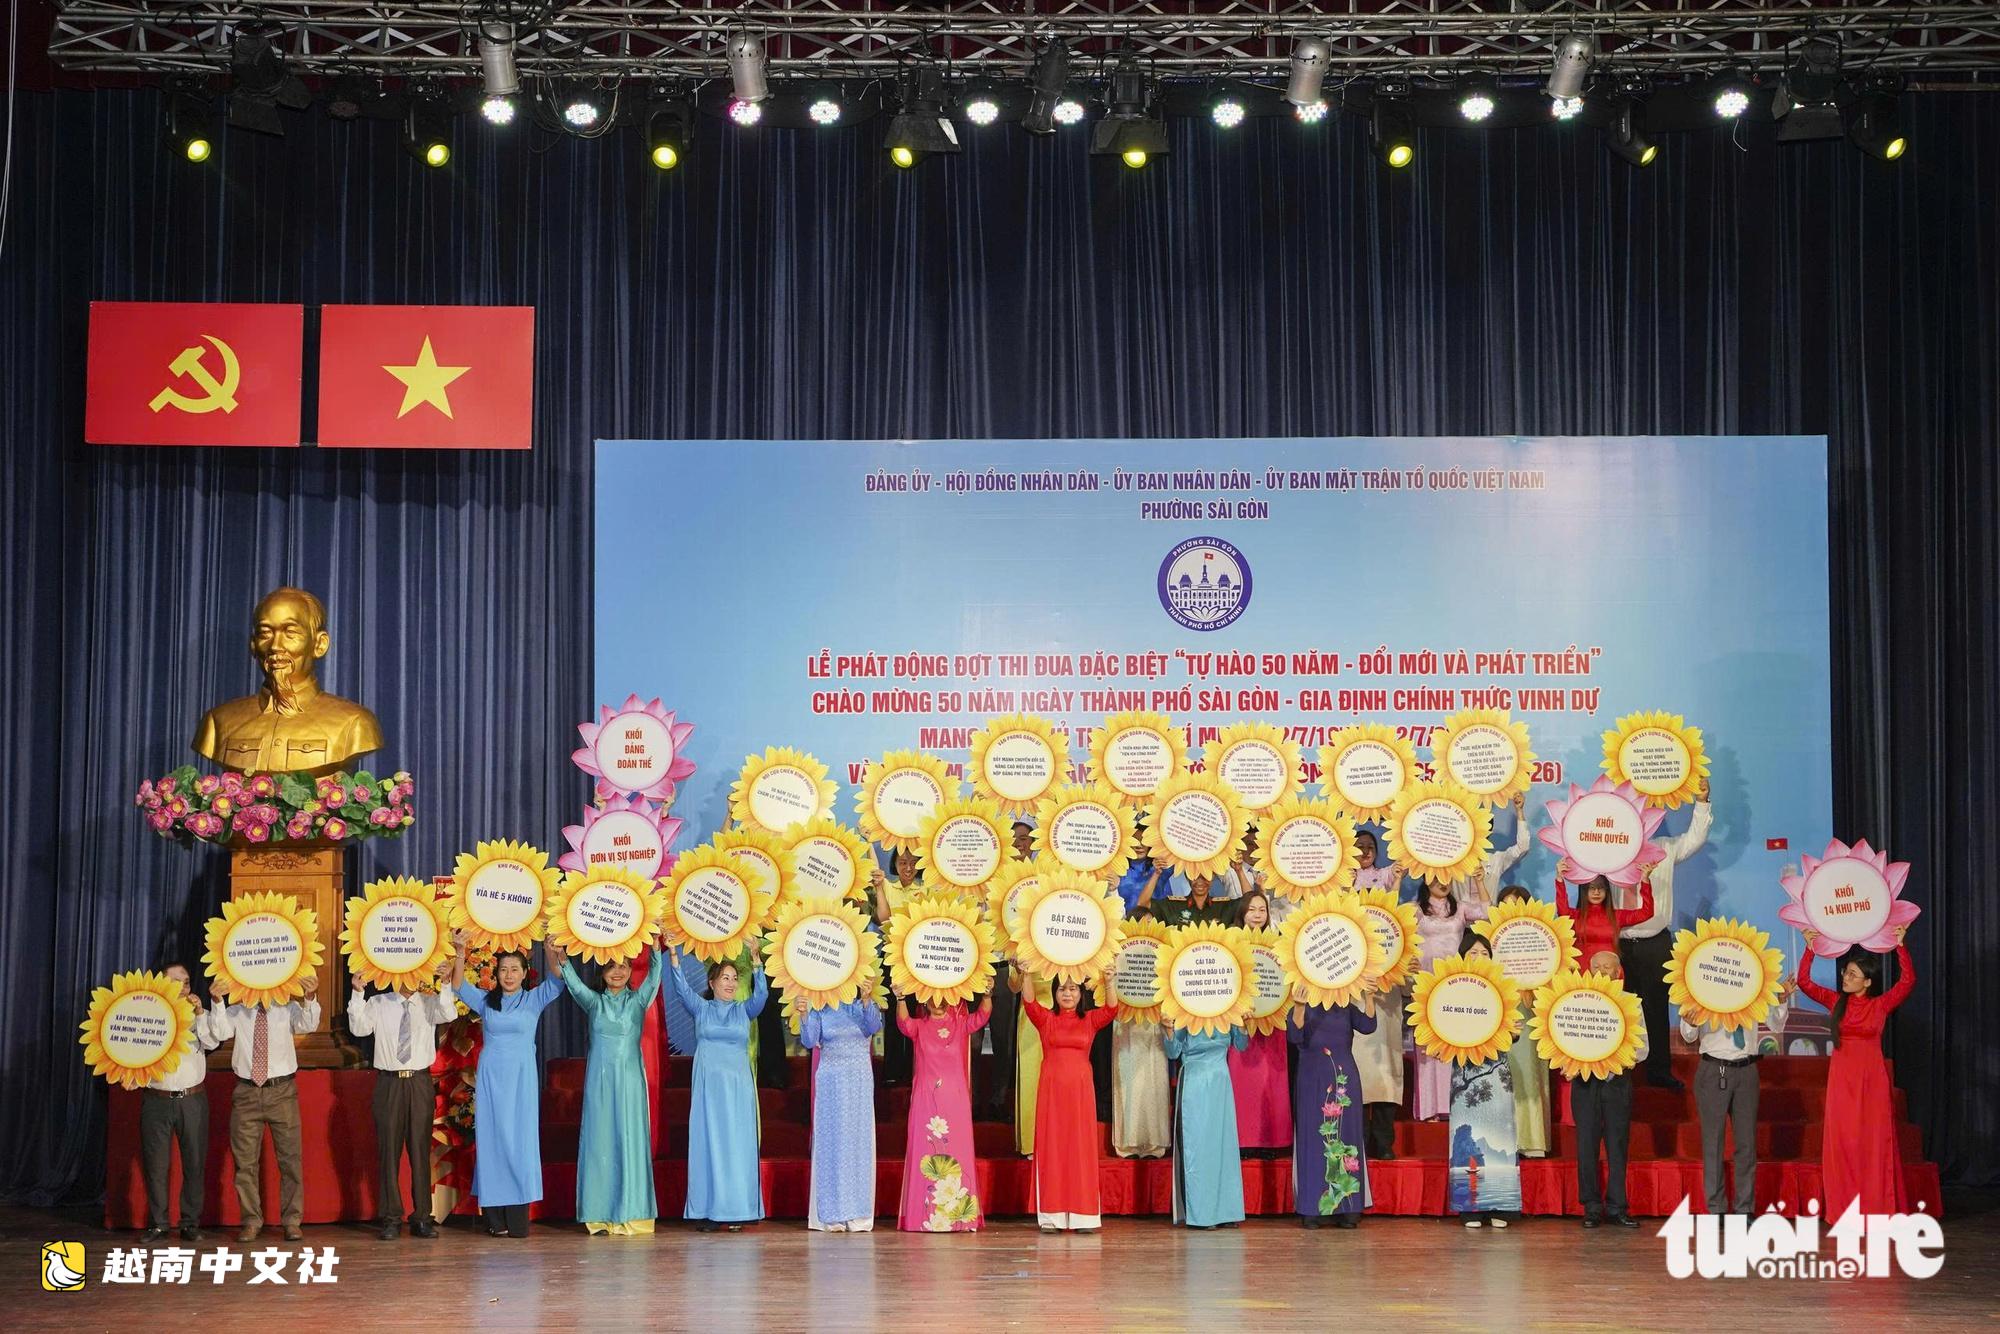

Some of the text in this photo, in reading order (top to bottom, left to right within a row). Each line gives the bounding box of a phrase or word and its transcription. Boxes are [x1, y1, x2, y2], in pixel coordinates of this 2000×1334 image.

[866, 469, 907, 492] ĐẢNG
[912, 469, 930, 491] ỦY
[946, 471, 970, 495] HỘI
[975, 469, 1016, 491] ĐỒNG
[1021, 471, 1062, 491] NHÂN
[1068, 470, 1098, 490] DÂN
[1114, 468, 1132, 490] ỦY
[1138, 473, 1168, 490] BAN
[1174, 470, 1214, 490] NHÂN
[1220, 470, 1250, 489] DÂN
[1267, 467, 1285, 489] ỦY
[1290, 473, 1320, 489] BAN
[1326, 469, 1357, 493] MẶT
[1362, 469, 1400, 492] TRẬN
[1406, 465, 1424, 488] TỔ
[1429, 466, 1468, 490] QUỐC
[1474, 469, 1503, 492] VIỆT
[1509, 472, 1544, 488] NAM
[1142, 498, 1268, 519] PHƯỜNG SÀI GÒN
[808, 649, 829, 677] LỄ
[838, 652, 887, 677] PHÁT
[894, 652, 948, 681] ĐỘNG
[955, 655, 992, 681] ĐỢT
[999, 656, 1028, 676] THI
[1034, 655, 1073, 676] ĐUA
[1079, 651, 1119, 680] ĐẶC
[1126, 651, 1168, 680] BIỆT
[1217, 651, 1255, 675] HÀO
[1263, 655, 1285, 675] 50
[1293, 651, 1338, 675] NĂM
[1359, 647, 1392, 675] ĐỔI
[1400, 650, 1437, 675] MỚI
[1444, 650, 1469, 674] VÀ
[1476, 649, 1525, 674] PHÁT
[813, 689, 865, 713] CHÀO
[872, 689, 932, 713] MỪNG
[938, 692, 962, 712] 50
[969, 688, 1016, 712] NĂM
[1022, 688, 1074, 712] NGÀY
[1080, 687, 1145, 712] THÀNH
[1153, 684, 1193, 711] PHỐ
[1199, 687, 1231, 711] SÀI
[1238, 686, 1279, 711] GÒN
[1300, 691, 1332, 711] GIA
[1339, 690, 1387, 715] ĐỊNH
[1394, 686, 1454, 710] CHÍNH
[1461, 686, 1511, 710] THỨC
[1519, 690, 1564, 710] VINH
[1572, 688, 1600, 715] DỰ
[626, 727, 642, 740] KHỐI
[625, 742, 644, 754] ĐẢNG
[617, 756, 653, 769] ĐOÀN THỂ
[1596, 816, 1613, 828] KHỐI
[614, 833, 631, 846] KHỐI
[1580, 831, 1629, 844] CHÍNH QUYỀN
[591, 847, 656, 864] ĐƠN VỊ SỰ NGHIỆP
[1835, 884, 1854, 898] KHỐI
[1824, 898, 1871, 916] 14 KHU PHỐ
